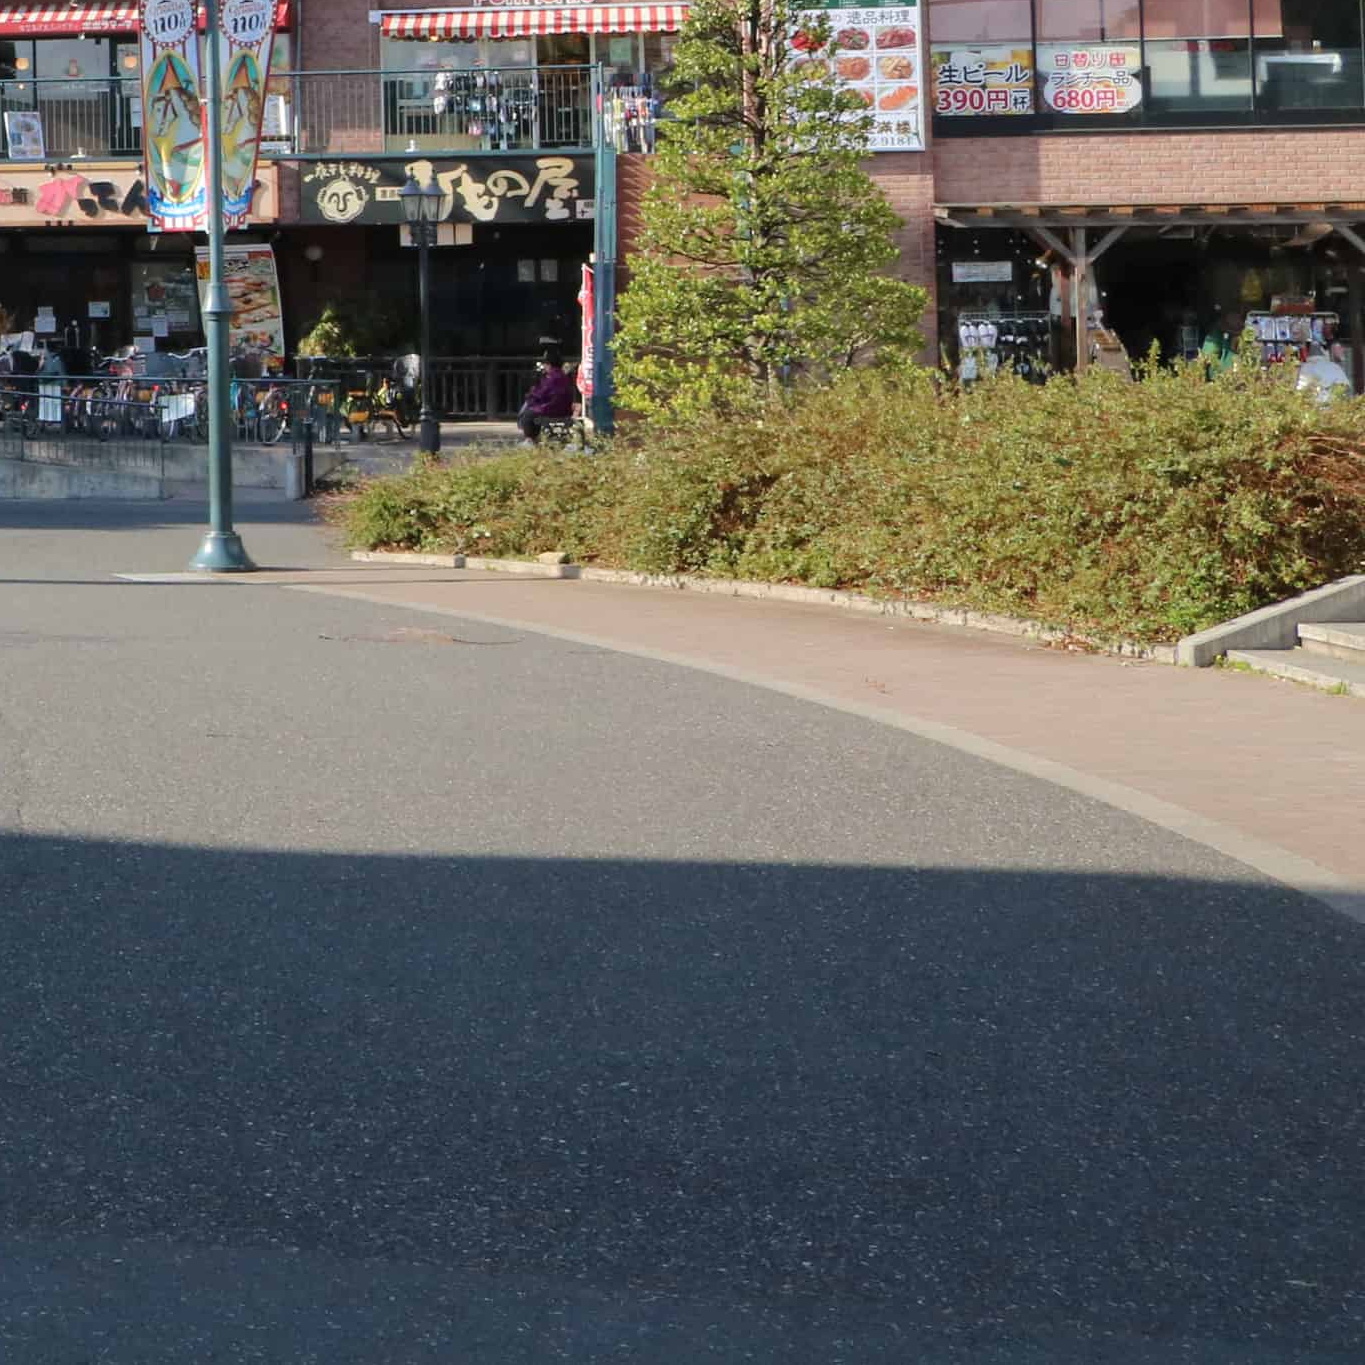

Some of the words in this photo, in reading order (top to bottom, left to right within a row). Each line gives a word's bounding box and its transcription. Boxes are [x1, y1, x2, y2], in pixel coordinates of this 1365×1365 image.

[153, 13, 179, 36] 110
[232, 14, 260, 34] 110
[938, 64, 1029, 85] 生ビール
[937, 89, 1009, 112] 390円
[1053, 89, 1117, 110] 680円
